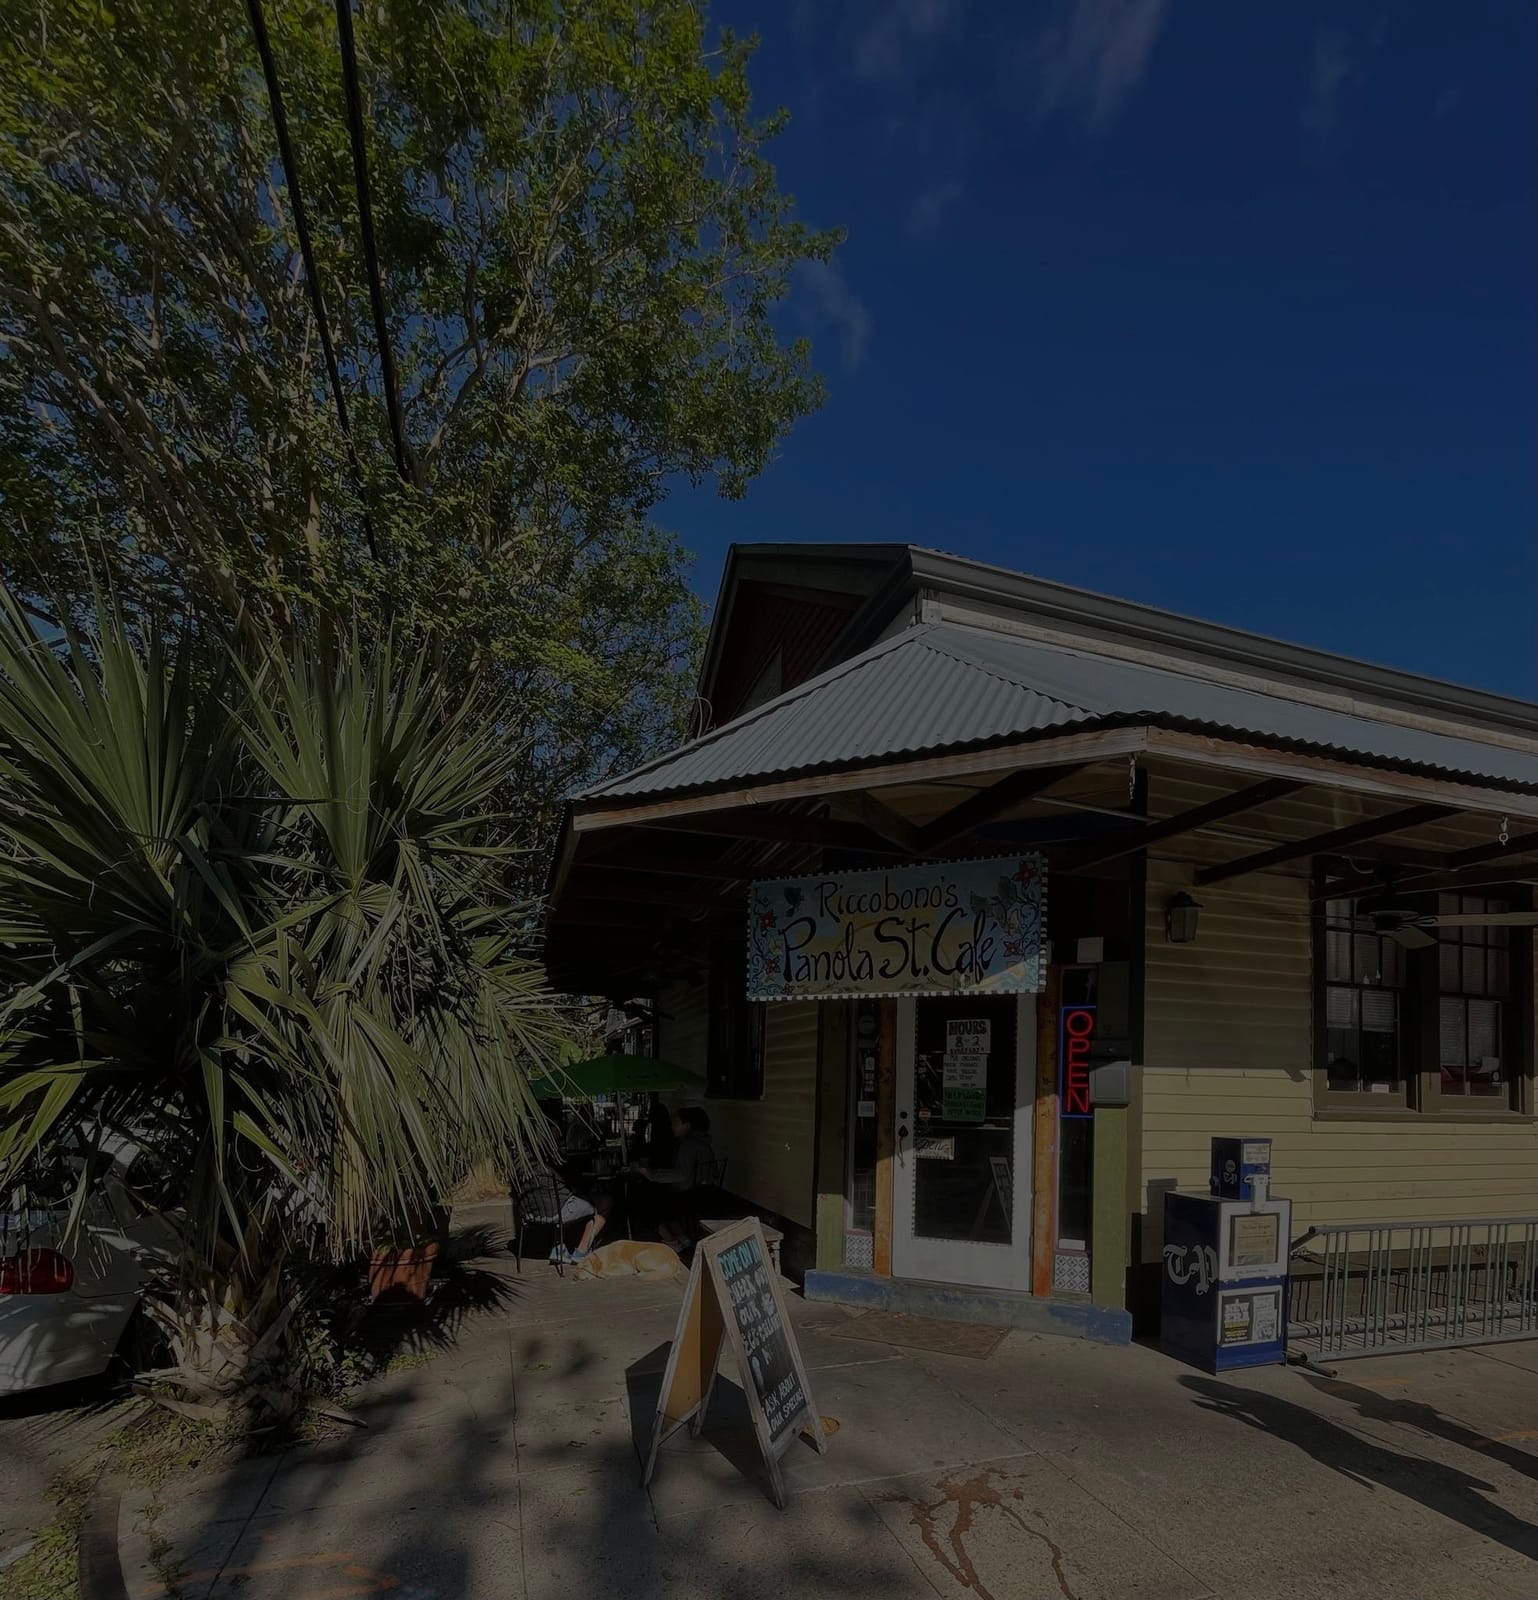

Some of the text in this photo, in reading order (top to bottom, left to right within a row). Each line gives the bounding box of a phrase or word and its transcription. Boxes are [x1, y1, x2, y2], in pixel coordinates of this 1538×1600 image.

[816, 876, 958, 922] Riccobono's
[779, 908, 997, 984] Panola St. Café
[949, 1021, 986, 1035] HOURS
[1065, 1009, 1095, 1113] OPEN
[764, 1371, 796, 1417] ASK ABOUT
[770, 1411, 784, 1432] OUR
